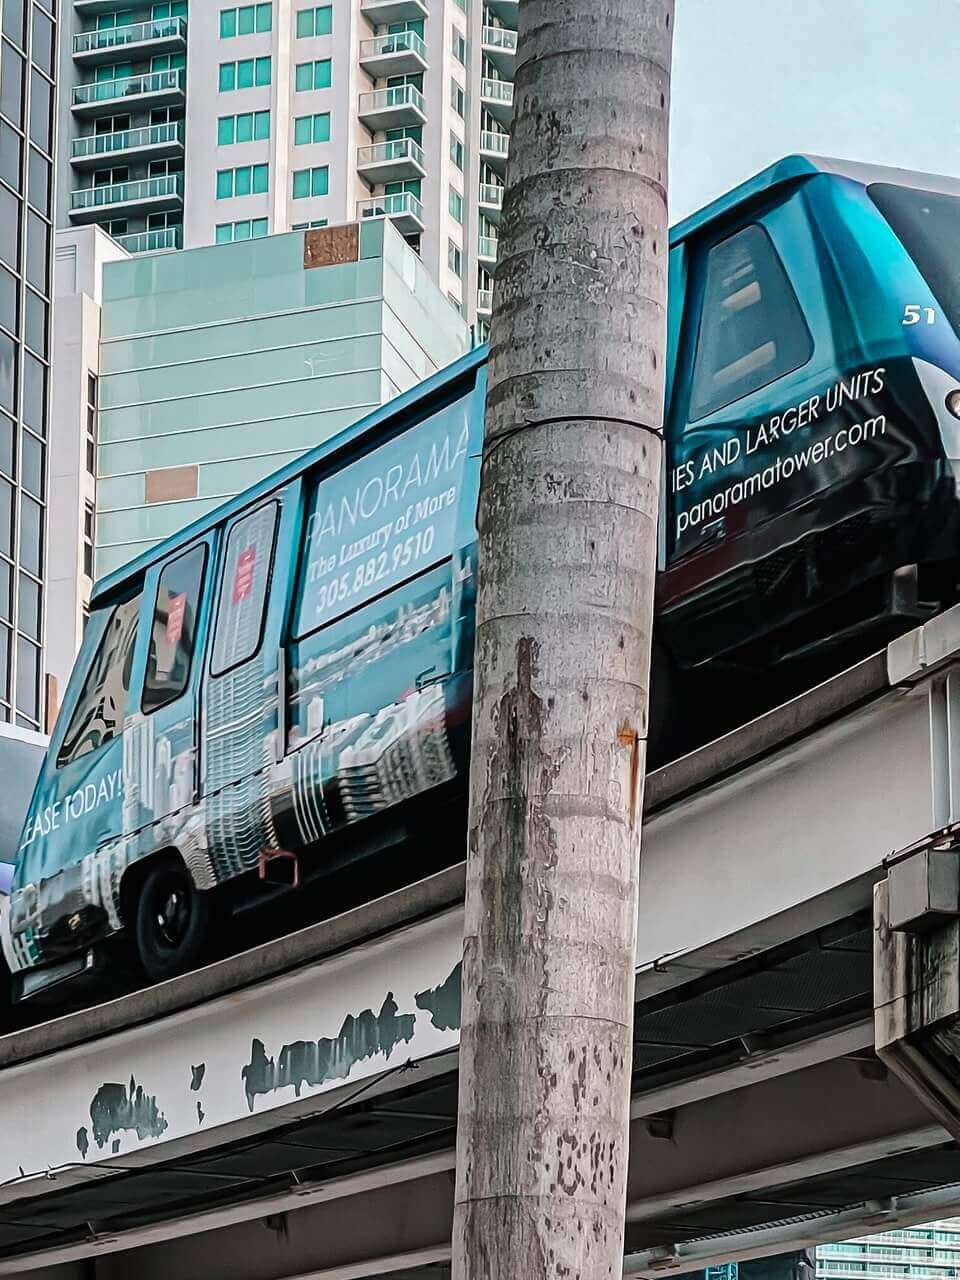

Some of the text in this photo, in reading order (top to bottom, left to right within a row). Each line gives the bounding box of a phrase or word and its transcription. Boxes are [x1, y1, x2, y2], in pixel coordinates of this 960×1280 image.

[901, 303, 937, 326] 51
[698, 437, 741, 481] AND
[745, 398, 820, 455] LARGER
[825, 366, 887, 412] UNITS
[675, 414, 887, 540] panoramatower.com
[310, 486, 457, 583] The Luxury of More
[316, 526, 435, 614] 305.882.9510
[64, 768, 122, 823] TODAY!
